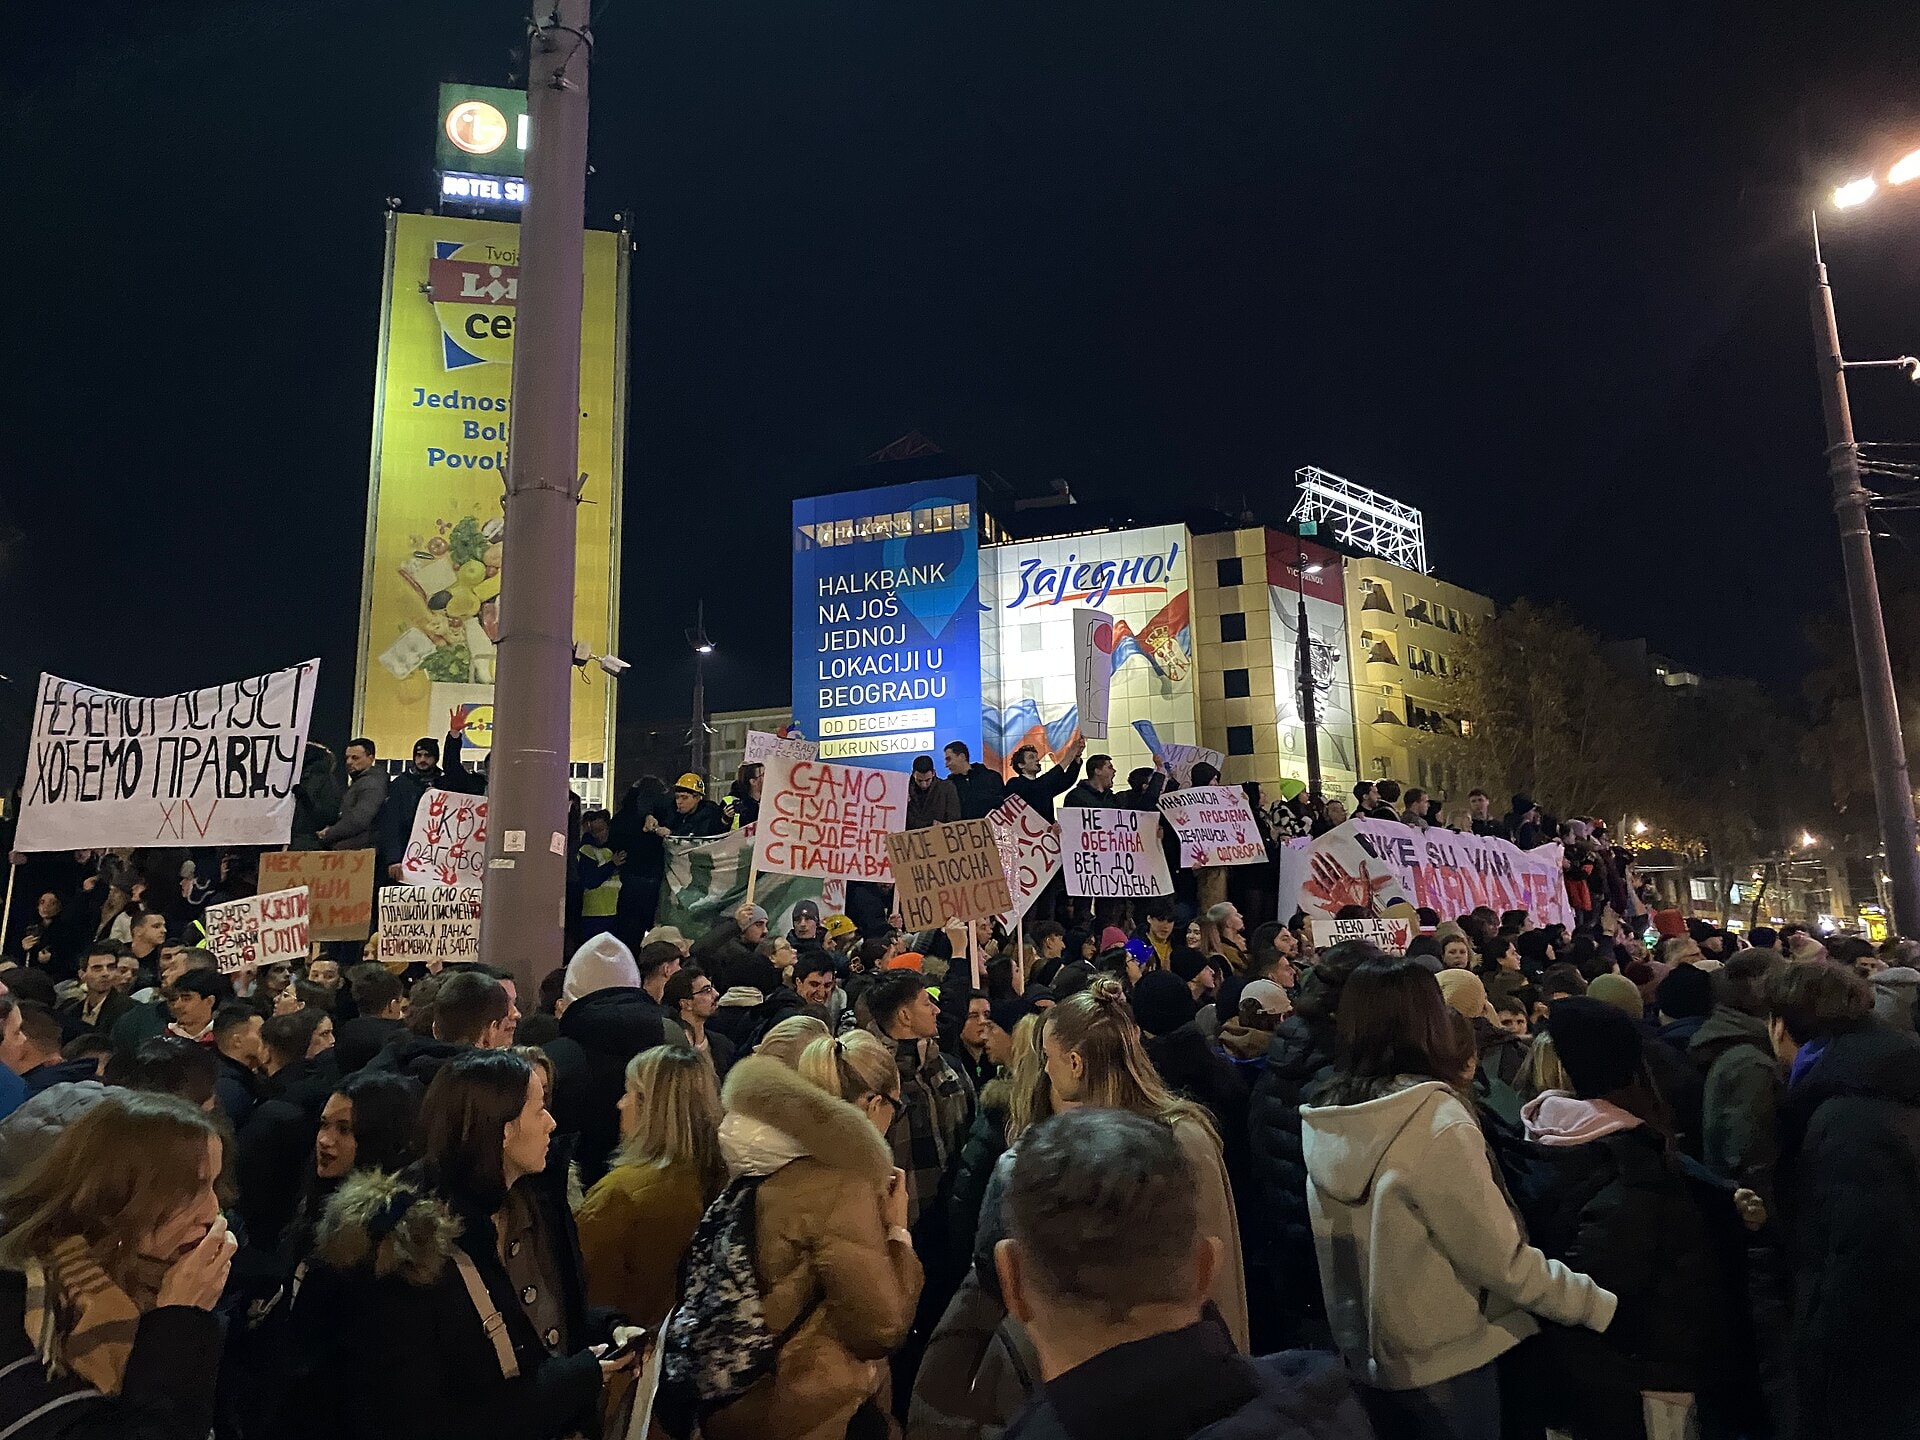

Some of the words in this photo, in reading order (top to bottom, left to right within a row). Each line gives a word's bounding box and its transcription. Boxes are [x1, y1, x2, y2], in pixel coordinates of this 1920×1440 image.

[443, 177, 501, 199] HOTEL
[485, 245, 519, 265] Tvoj
[465, 313, 515, 339] ce
[412, 387, 511, 412] Jednos
[463, 420, 508, 441] Bol
[427, 447, 507, 470] Povol
[835, 517, 912, 539] HALKBANK
[819, 562, 946, 597] HALKBANK
[819, 603, 851, 625] NA
[856, 591, 899, 621] JOŠ
[818, 623, 907, 653] JEDNOJ
[819, 650, 919, 681] LOKACIJI
[927, 648, 943, 670] U
[819, 676, 947, 709] BEOGRADU
[824, 721, 844, 734] OD
[849, 712, 930, 732] DECEM
[825, 743, 833, 757] U
[838, 737, 917, 756] KRUNSKOJ
[29, 737, 143, 806] ХОЋЕМО
[152, 734, 300, 799] ПРАВДУ
[789, 761, 887, 803] САМО
[774, 789, 897, 829] СТУДЕНТ
[1158, 791, 1220, 811] ИНФЛАЦИЈА
[1081, 808, 1103, 831] НЕ
[1114, 809, 1138, 832] ДО
[1199, 808, 1252, 824] ПРОБЛЕМА
[769, 816, 888, 855] СТУДЕНТ
[889, 829, 937, 865] НИЈЕ
[941, 820, 996, 854] ВРБА
[1081, 830, 1145, 853] ОБЕЋАЊА
[1177, 827, 1229, 844] ДЕФЛАЦИЈА
[1074, 851, 1102, 875] ВЕЋ
[1110, 852, 1135, 876] ДО
[1216, 842, 1265, 862] ОДГОВОРА
[910, 851, 993, 894] ЖАЛОСНА
[382, 886, 427, 905] НЕКАД
[432, 886, 457, 903] СМО
[1079, 872, 1162, 897] ИСПУЊЕЊА
[381, 903, 430, 923] ПЛАШИЛИ
[907, 895, 934, 929] НО
[430, 924, 436, 938] А
[440, 923, 473, 940] ДАНАС
[1334, 919, 1364, 934] НЕКО
[1371, 918, 1385, 932] ЈЕ
[436, 938, 448, 956] НА
[450, 937, 479, 956] ЗАДАТК
